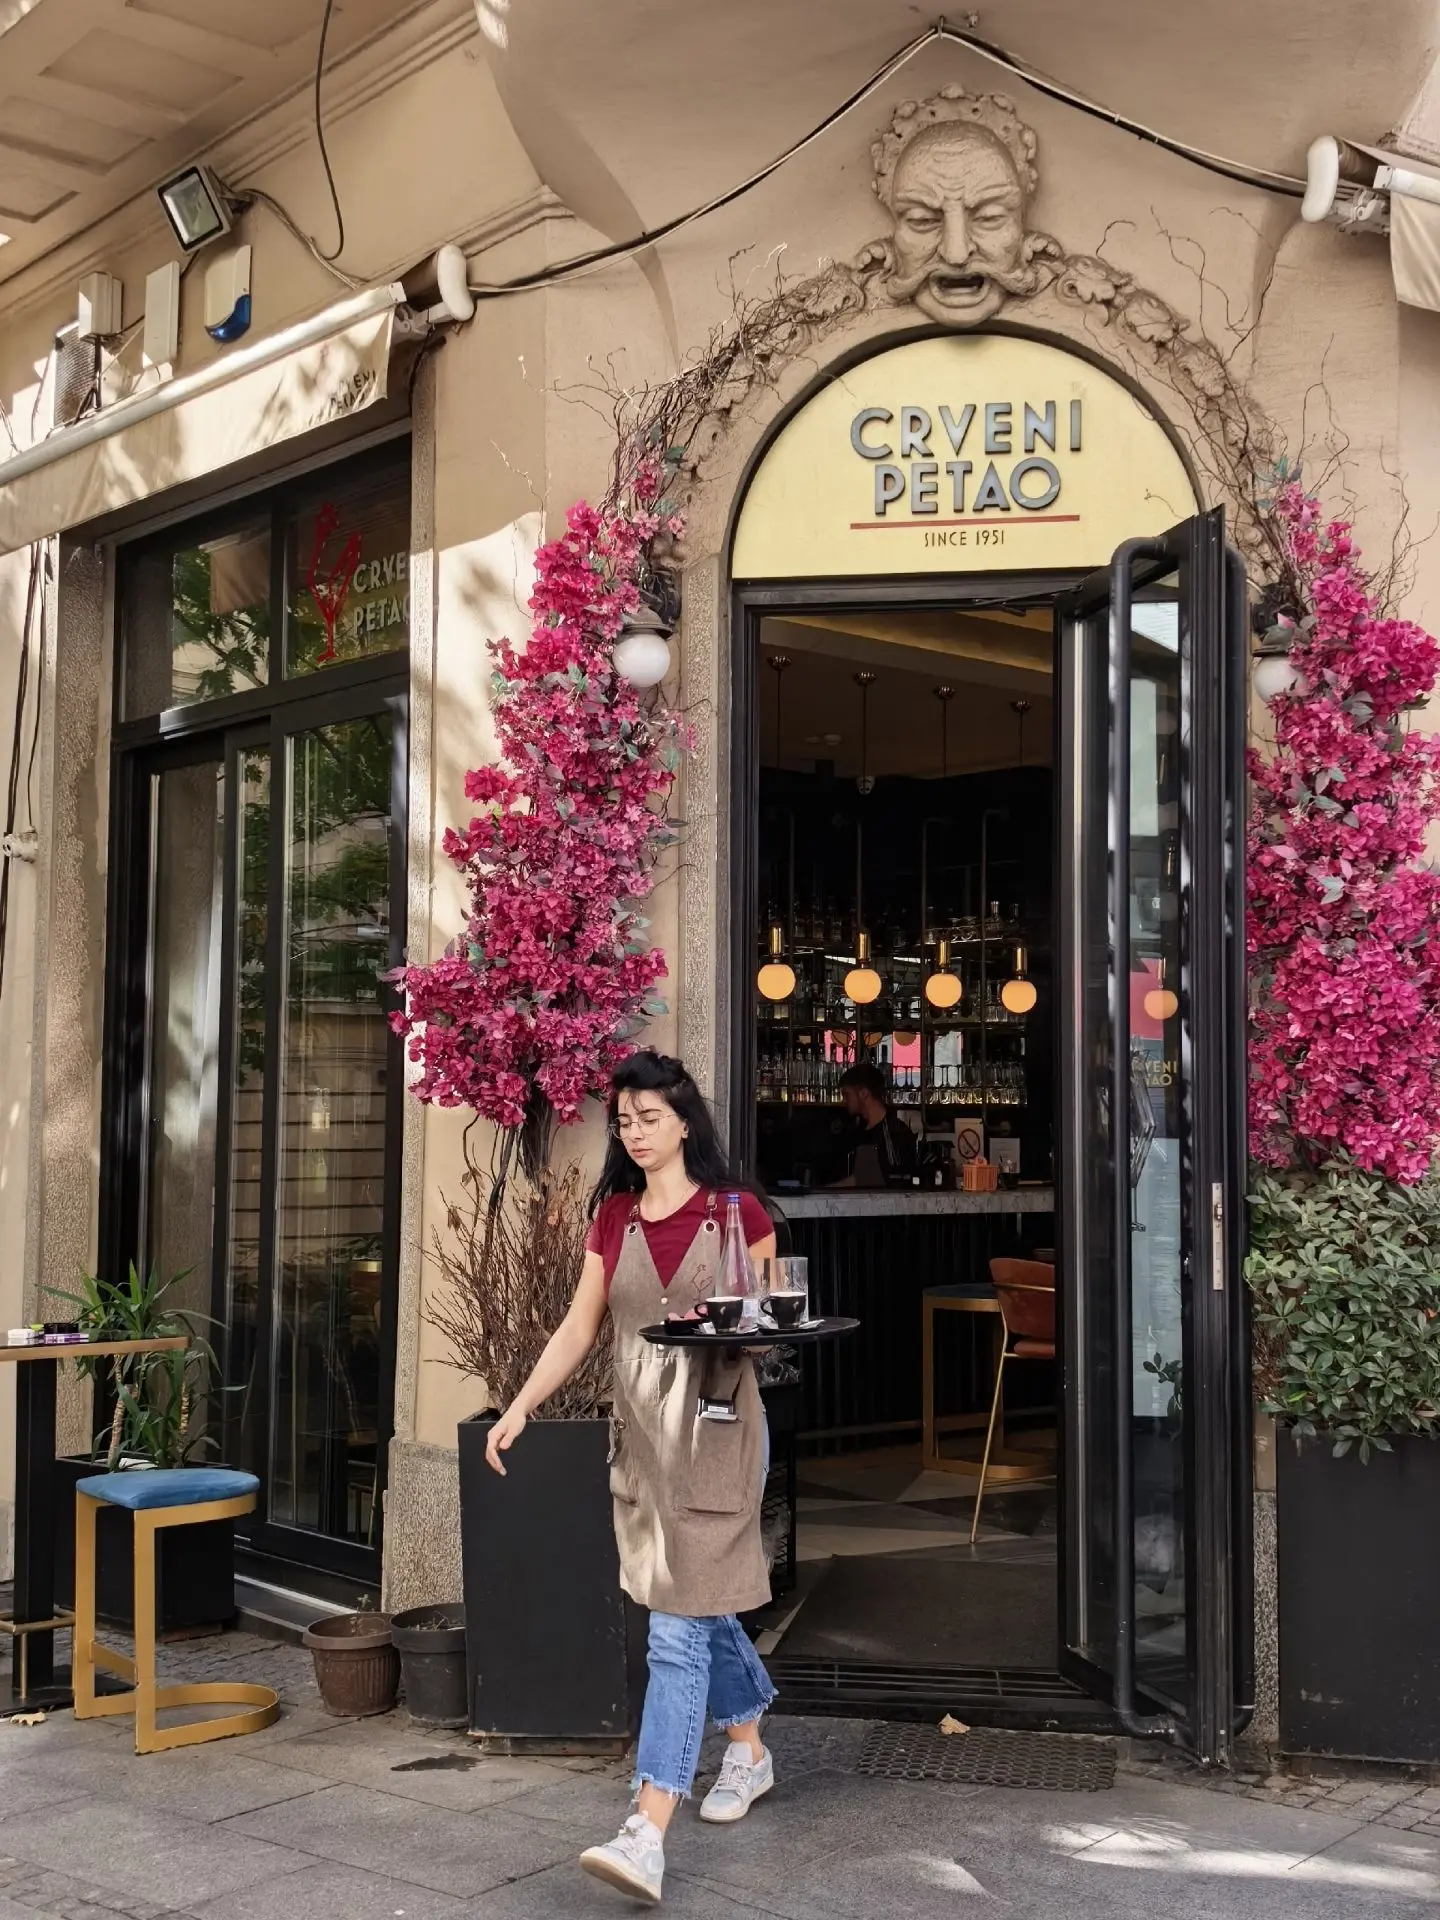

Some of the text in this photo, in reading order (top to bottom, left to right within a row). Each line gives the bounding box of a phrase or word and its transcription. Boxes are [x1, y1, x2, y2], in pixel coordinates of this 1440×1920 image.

[850, 399, 1081, 459] CRVENI
[875, 456, 1061, 516] PETAO
[924, 529, 1005, 547] SINCE 1951
